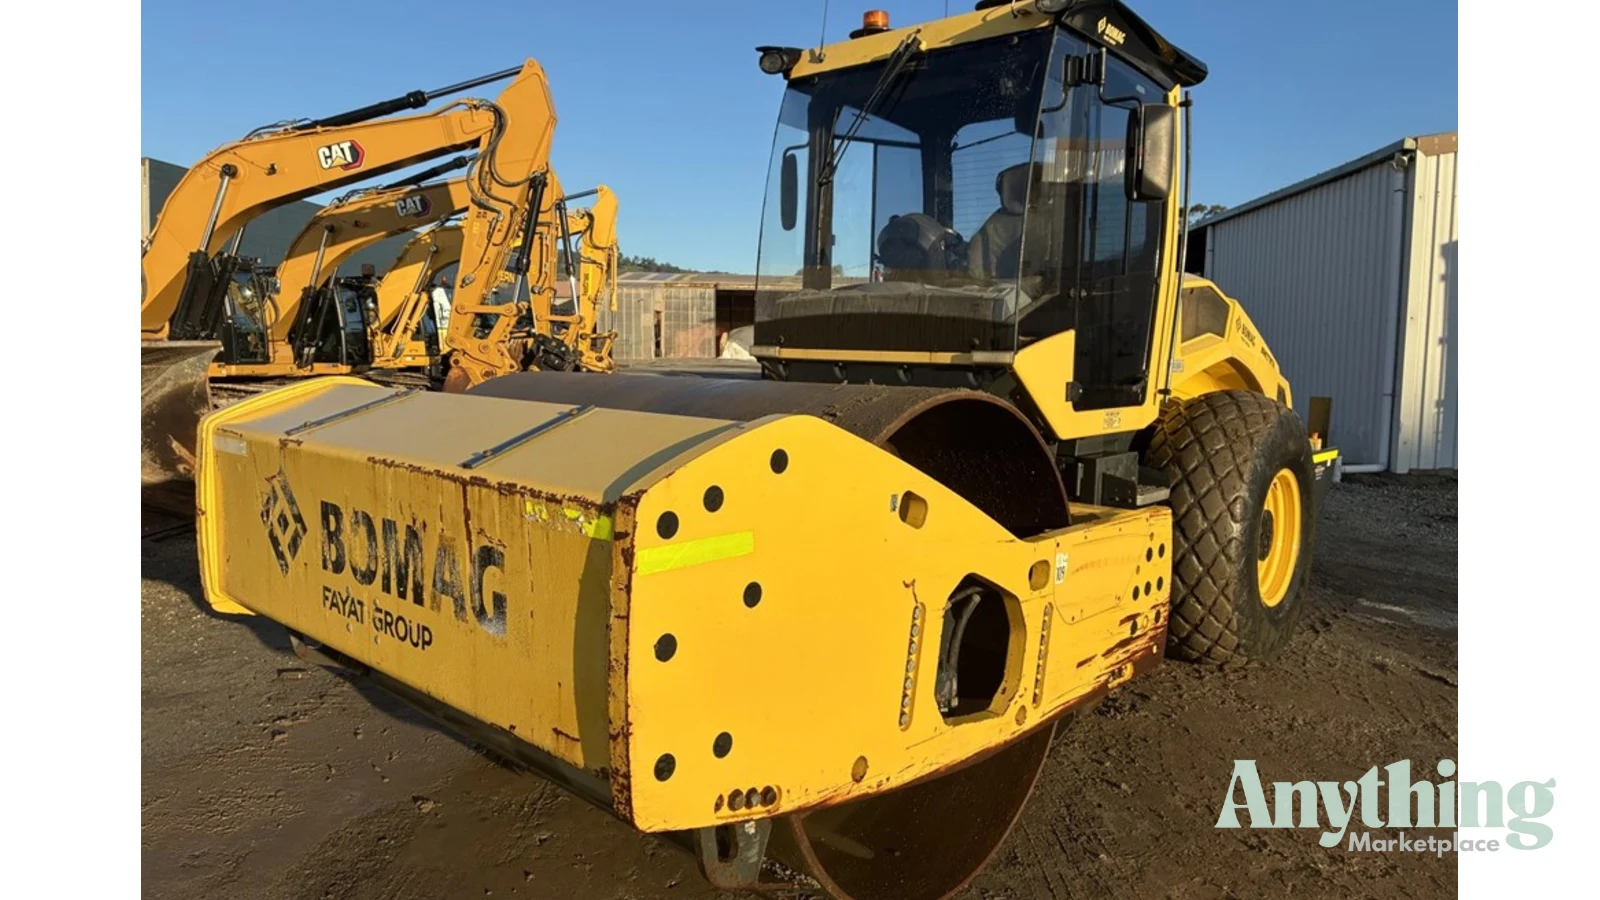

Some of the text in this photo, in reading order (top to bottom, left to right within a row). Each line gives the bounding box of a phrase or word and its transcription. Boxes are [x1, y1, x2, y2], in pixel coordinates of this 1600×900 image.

[318, 141, 353, 169] CAT
[396, 196, 423, 217] CAT
[320, 500, 507, 638] BOMAG
[322, 585, 433, 650] FAYAT GROUP
